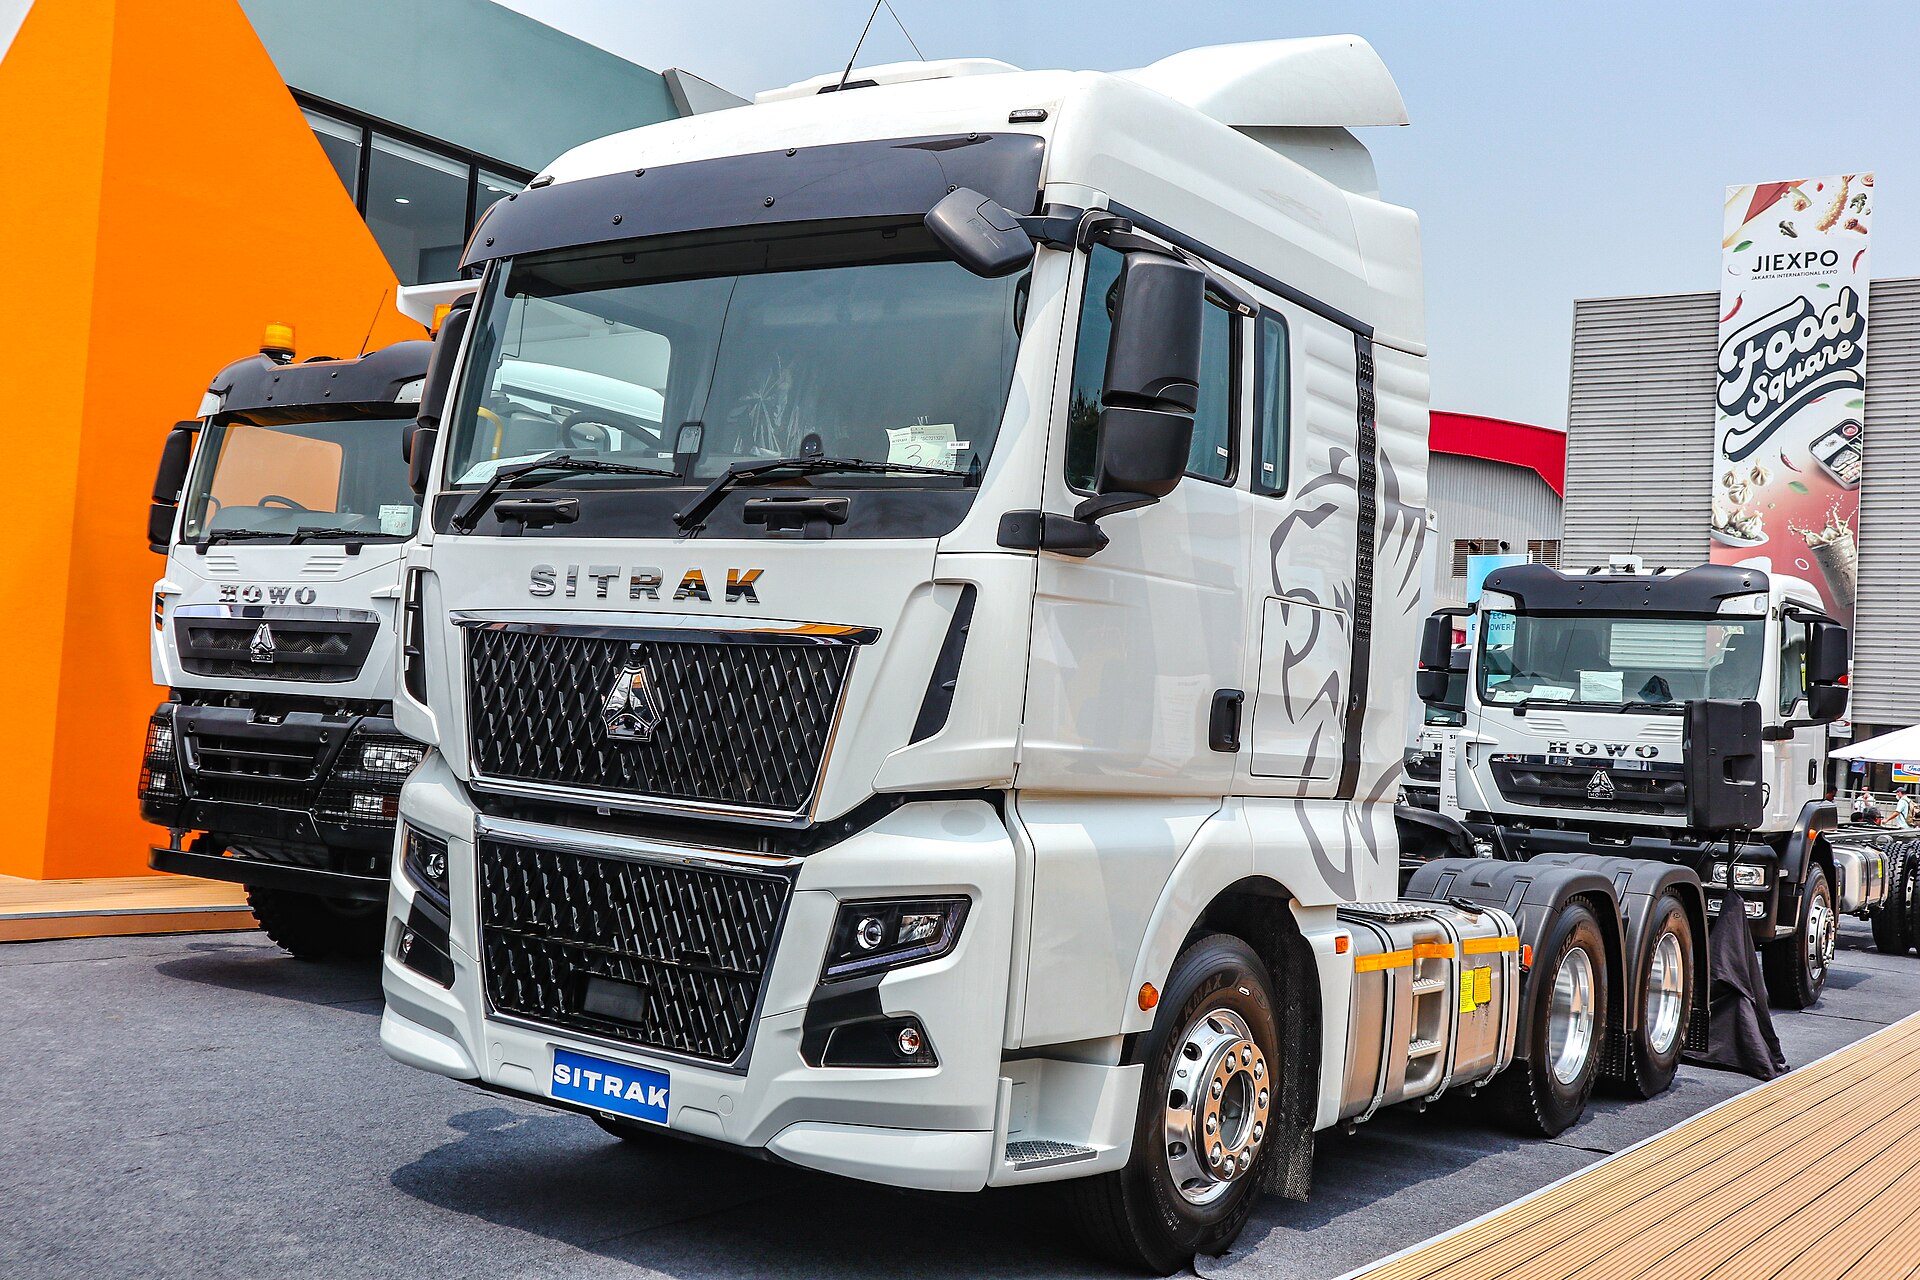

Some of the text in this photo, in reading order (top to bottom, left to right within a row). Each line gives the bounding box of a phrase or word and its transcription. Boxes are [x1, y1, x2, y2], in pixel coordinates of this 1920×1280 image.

[1751, 250, 1839, 272] JIEXPO
[1717, 286, 1862, 408] Food
[1746, 339, 1857, 418] Square
[219, 584, 317, 605] HOWO
[528, 564, 765, 604] SITRAK
[1547, 741, 1660, 758] HOWO
[553, 1063, 669, 1109] SITRAK
